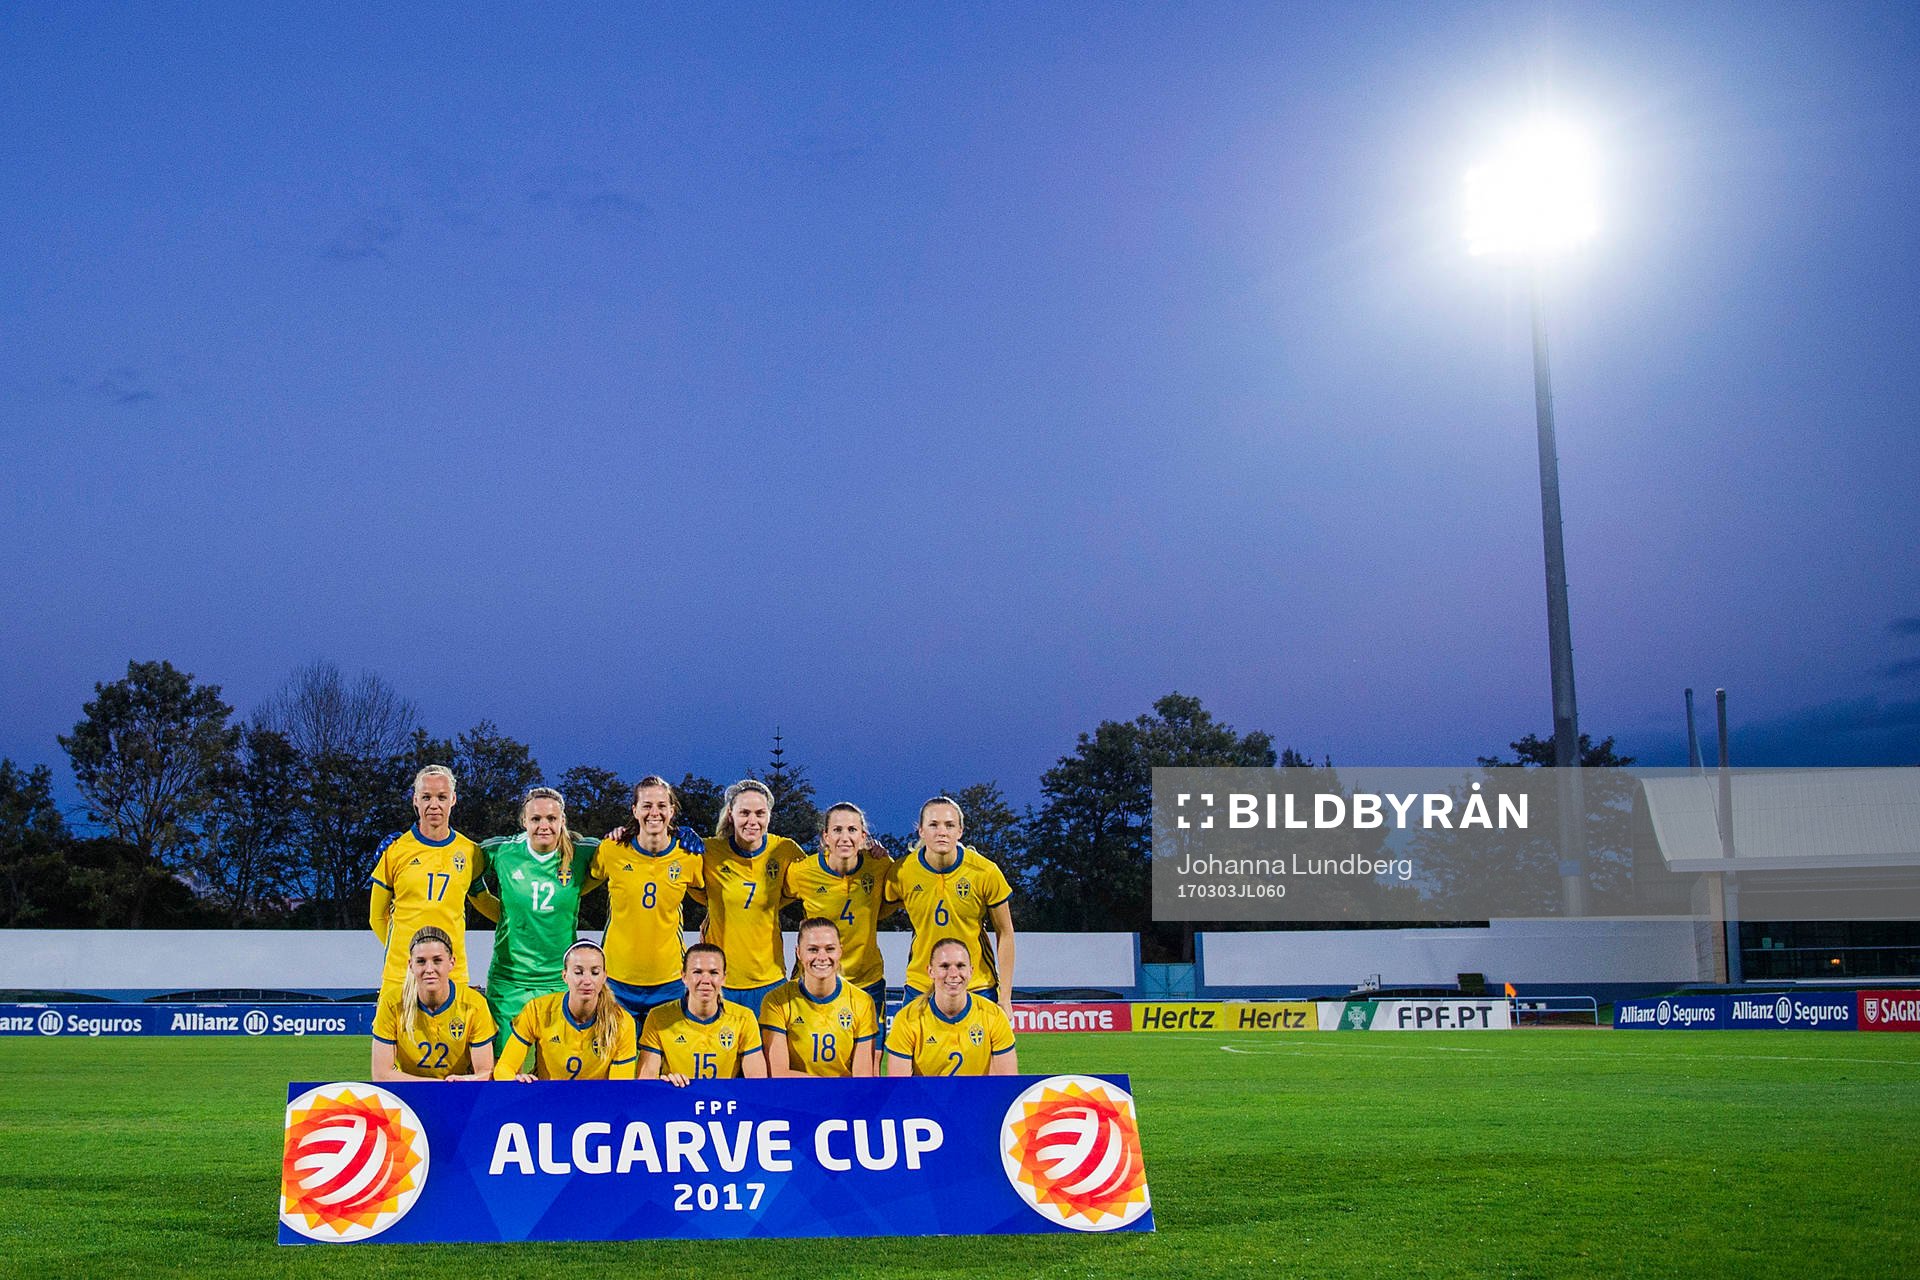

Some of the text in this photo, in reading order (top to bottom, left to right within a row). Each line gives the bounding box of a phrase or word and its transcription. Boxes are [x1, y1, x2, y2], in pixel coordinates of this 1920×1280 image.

[427, 872, 450, 902] 17
[531, 880, 555, 912] 12
[641, 881, 656, 909] 8
[743, 882, 757, 909] 7
[840, 899, 855, 925] 4
[934, 899, 949, 927] 6
[67, 1015, 142, 1036] Seguros
[171, 1013, 346, 1036] Allianz Seguros
[1142, 1007, 1215, 1029] Hertz
[1238, 1008, 1307, 1029] Hertz
[1398, 1006, 1493, 1029] FPF.PT
[1620, 1004, 1716, 1026] Allianz Seguros
[1732, 1001, 1849, 1025] Allianz Seguros
[416, 1041, 449, 1069] 22
[811, 1033, 836, 1063] 18
[566, 1056, 582, 1080] 9
[693, 1052, 717, 1079] 15
[948, 1051, 964, 1077] 2
[695, 1100, 737, 1115] FPF
[489, 1117, 944, 1175] ALGARVE CUP
[673, 1182, 765, 1211] 2017
